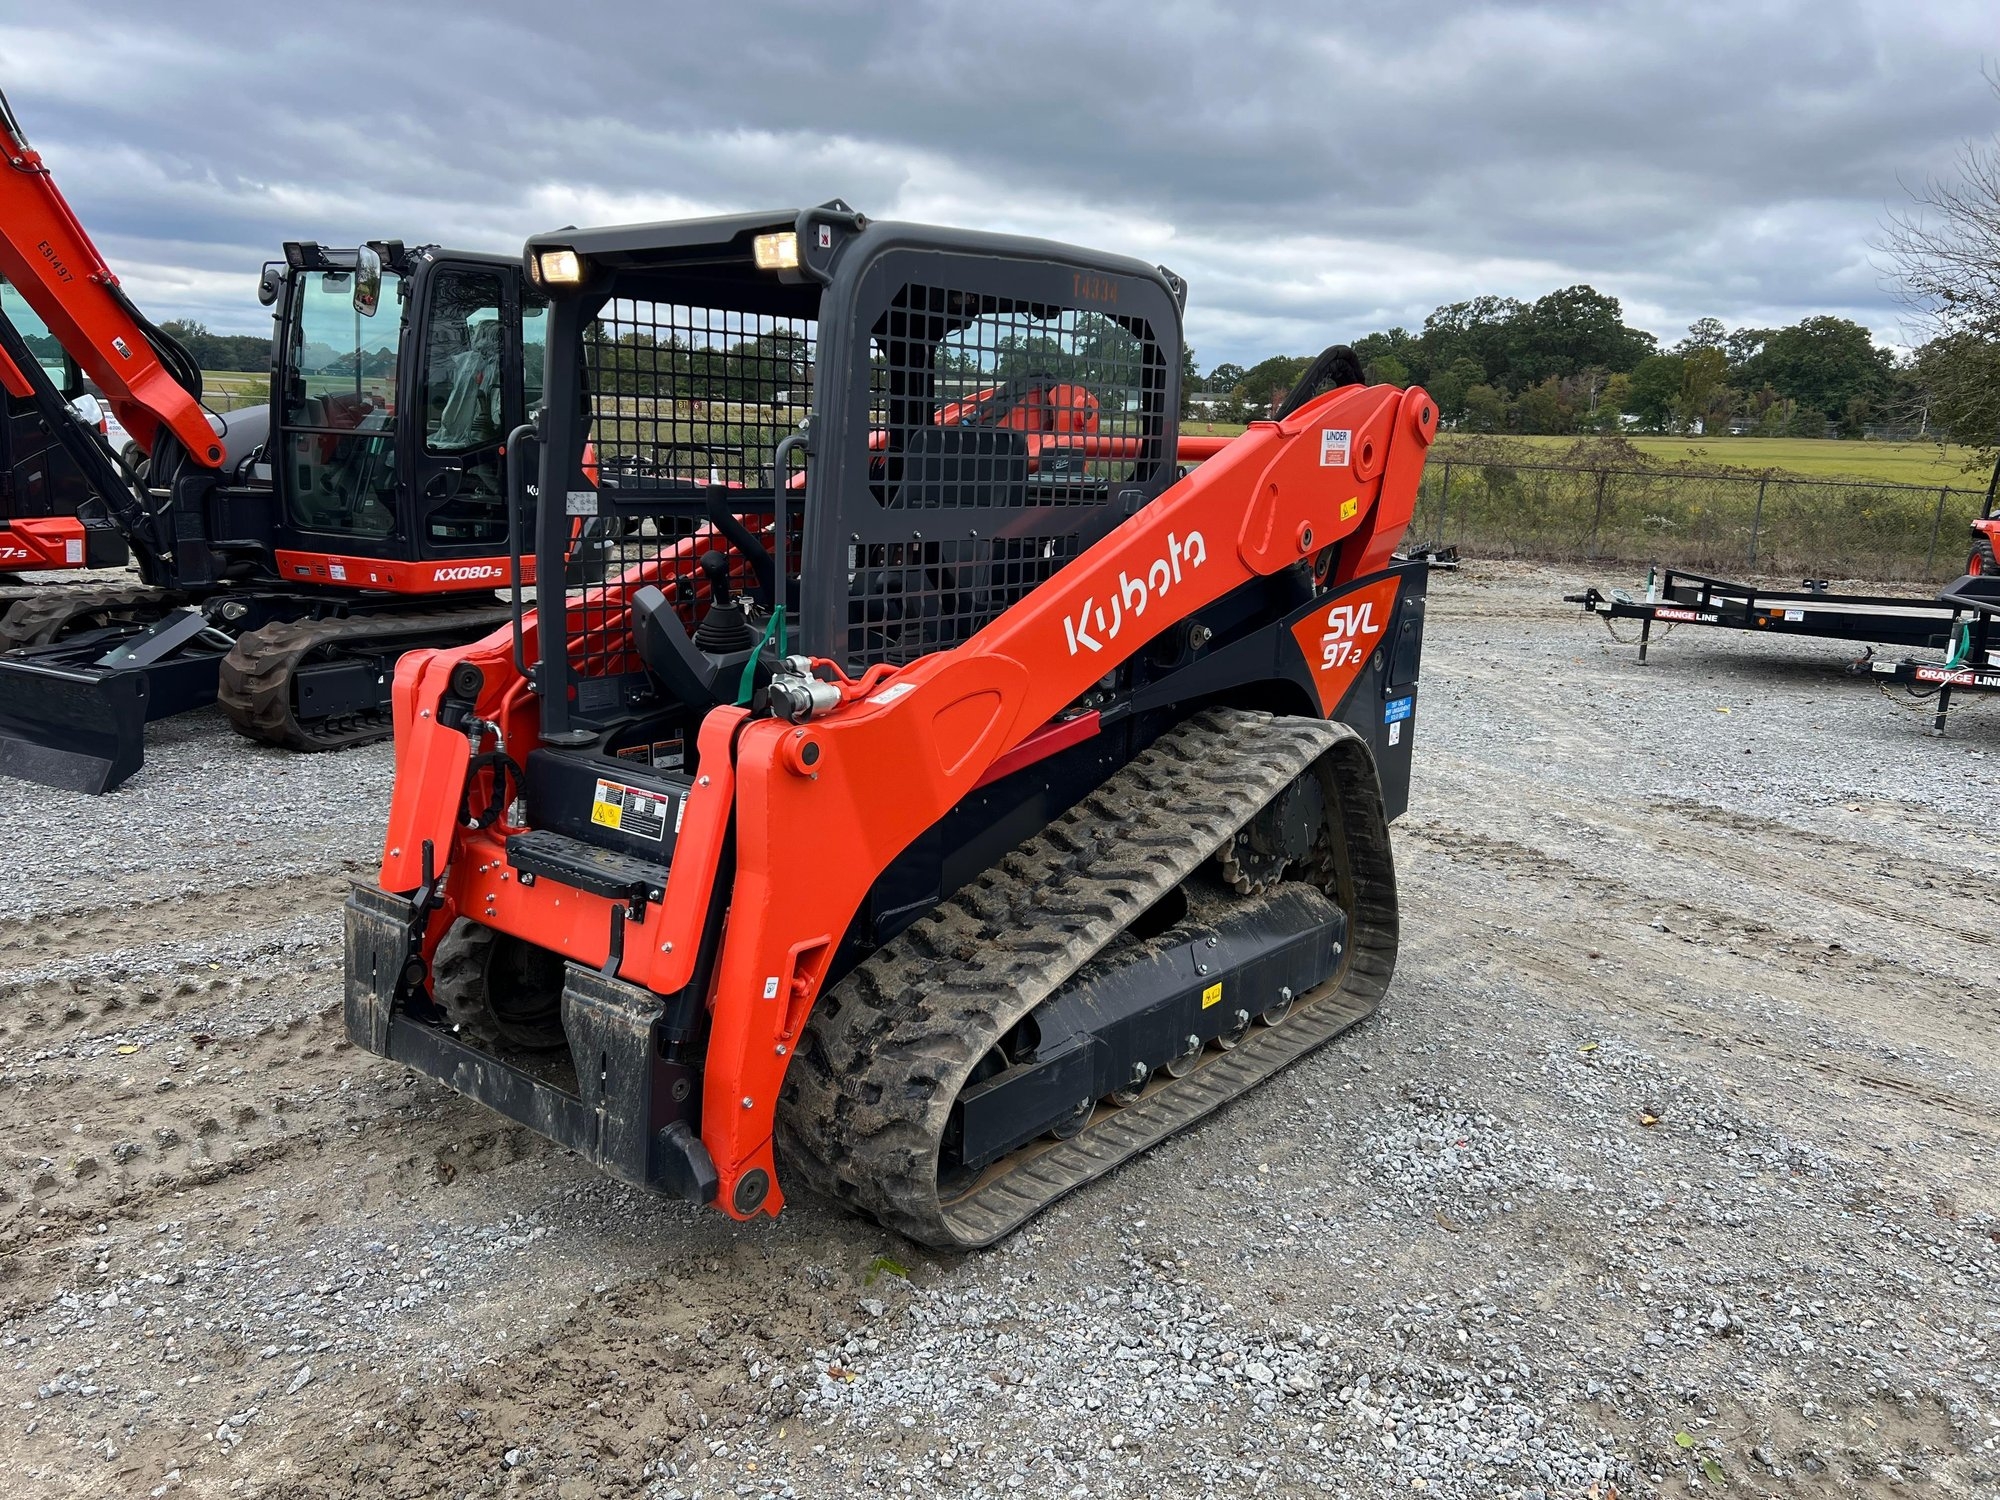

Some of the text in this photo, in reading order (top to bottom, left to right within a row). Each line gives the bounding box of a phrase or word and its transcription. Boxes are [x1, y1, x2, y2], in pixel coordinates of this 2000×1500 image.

[37, 240, 73, 283] E91497
[1327, 431, 1347, 440] LINDER
[527, 485, 539, 496] Ku
[0, 547, 28, 559] 7-5
[433, 565, 503, 581] KX080-5
[1063, 531, 1206, 656] Kubota
[1323, 602, 1379, 641] SVL
[1657, 610, 1718, 622] ORANGE LINE
[1320, 641, 1362, 670] 97-2
[1919, 670, 1972, 683] ORANGE
